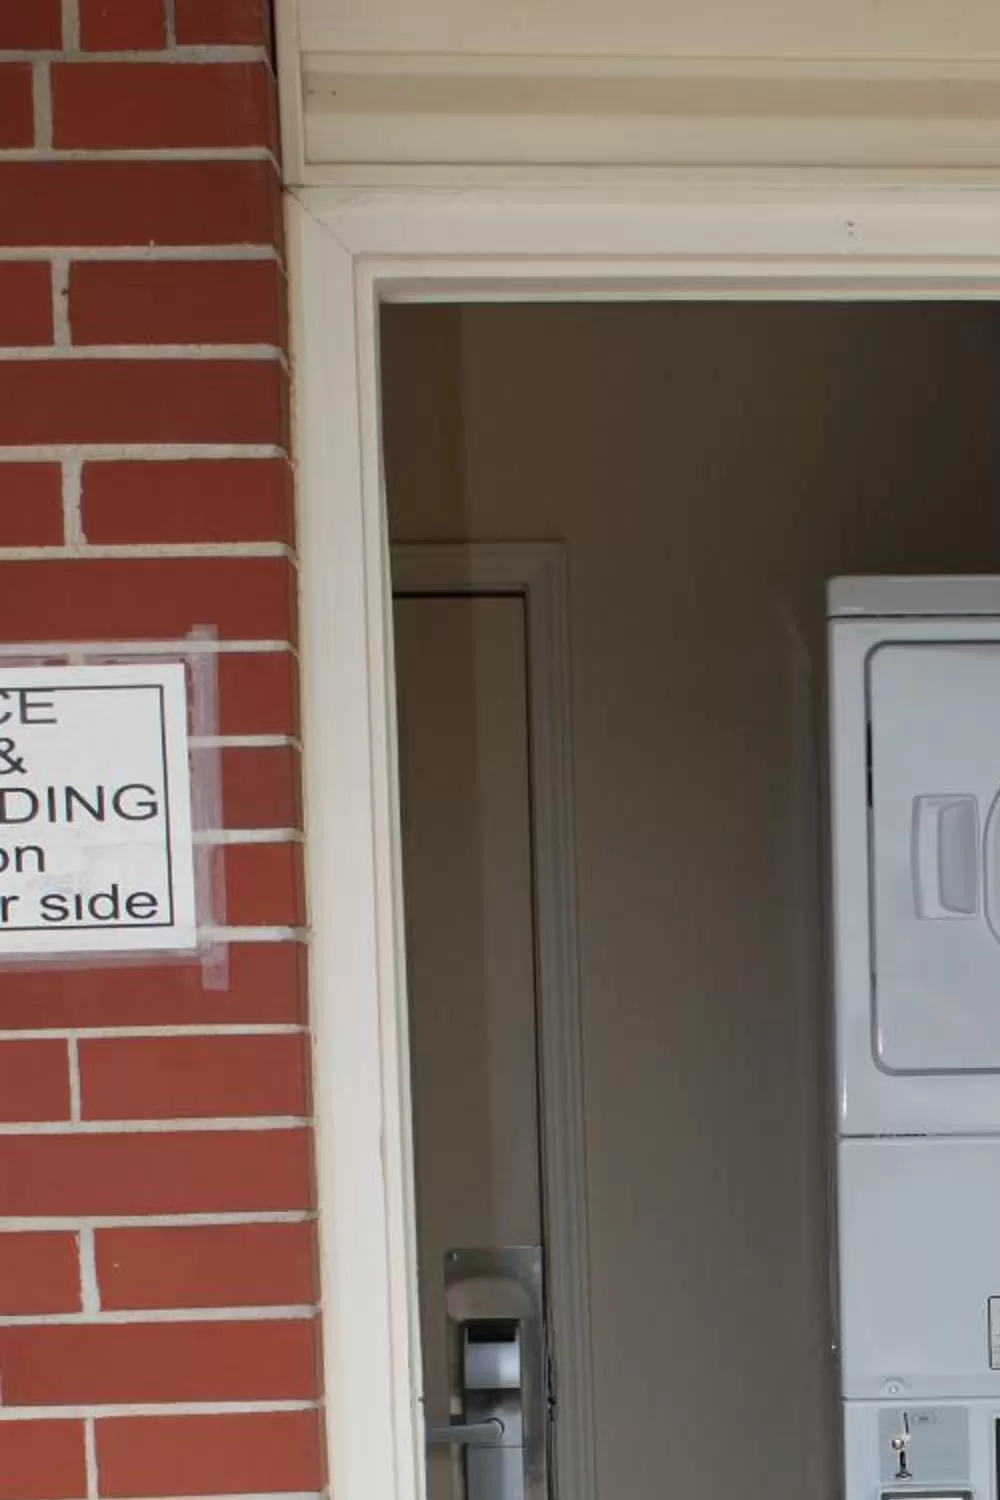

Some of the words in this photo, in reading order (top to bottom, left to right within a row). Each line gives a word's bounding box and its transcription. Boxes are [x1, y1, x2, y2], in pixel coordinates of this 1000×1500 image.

[0, 688, 58, 725] E
[0, 784, 159, 825] DING
[0, 845, 46, 873] n
[40, 883, 159, 922] side
